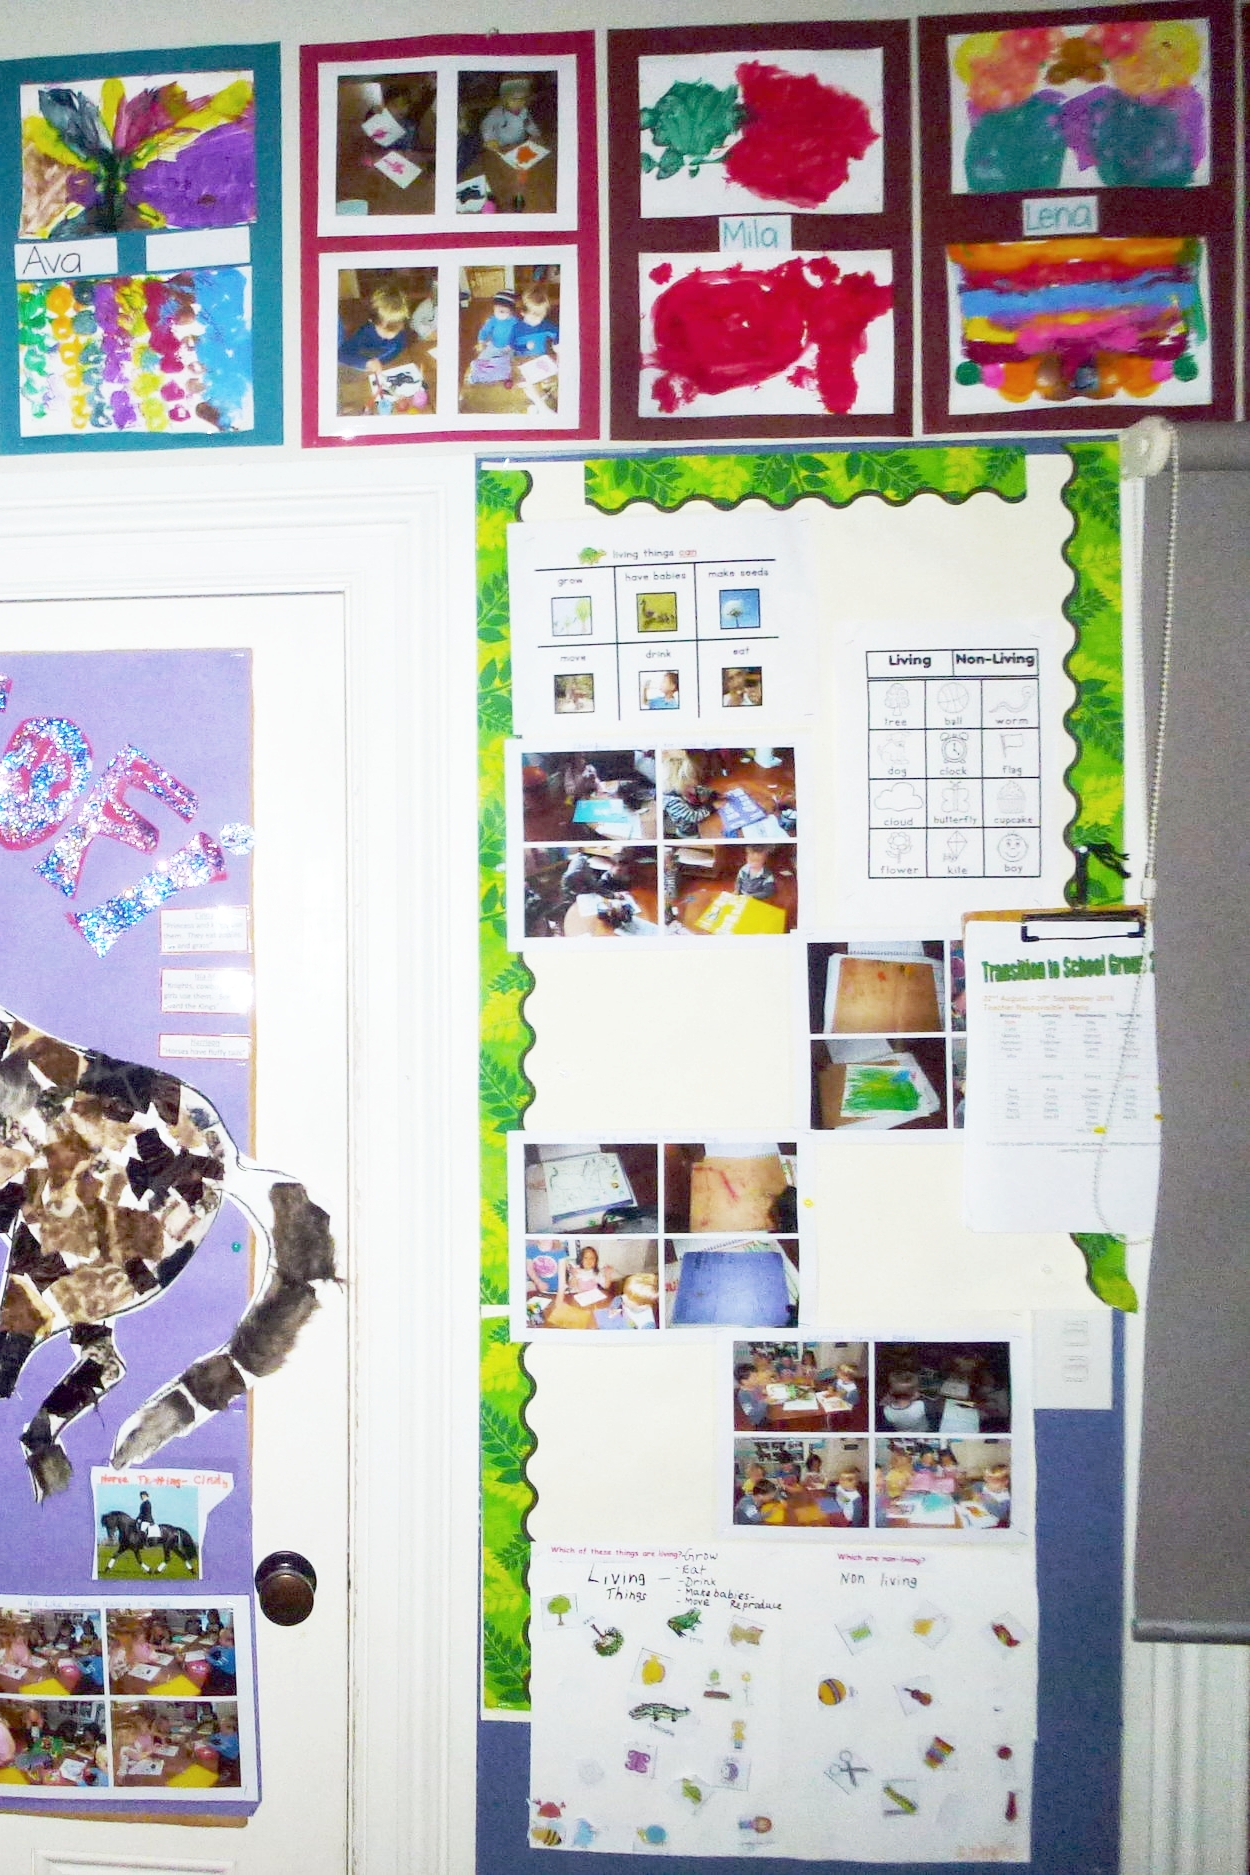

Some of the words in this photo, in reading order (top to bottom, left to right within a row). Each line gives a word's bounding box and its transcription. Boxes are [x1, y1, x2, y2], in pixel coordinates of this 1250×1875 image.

[1024, 199, 1092, 232] Lena
[723, 219, 778, 248] Mila
[21, 243, 85, 276] Ava
[613, 550, 638, 560] living
[643, 548, 674, 559] things
[625, 573, 649, 581] have
[653, 571, 686, 580] babies
[708, 568, 735, 577] make
[740, 567, 769, 577] seeds
[558, 579, 583, 587] grow
[646, 649, 671, 659] drink
[733, 647, 750, 655] eat
[560, 654, 587, 663] move
[889, 654, 931, 668] Living
[956, 652, 1035, 667] Non-Living
[888, 766, 907, 777] dog
[940, 766, 968, 775] clock
[1002, 765, 1022, 776] flag
[884, 817, 913, 826] cloud
[934, 815, 977, 825] butterfly
[994, 816, 1033, 826] cupcake
[880, 866, 919, 874] flower
[1004, 864, 1023, 874] boy
[616, 1549, 638, 1558] things
[587, 1564, 646, 1586] Living
[880, 1573, 917, 1589] living
[607, 1587, 646, 1602] Things
